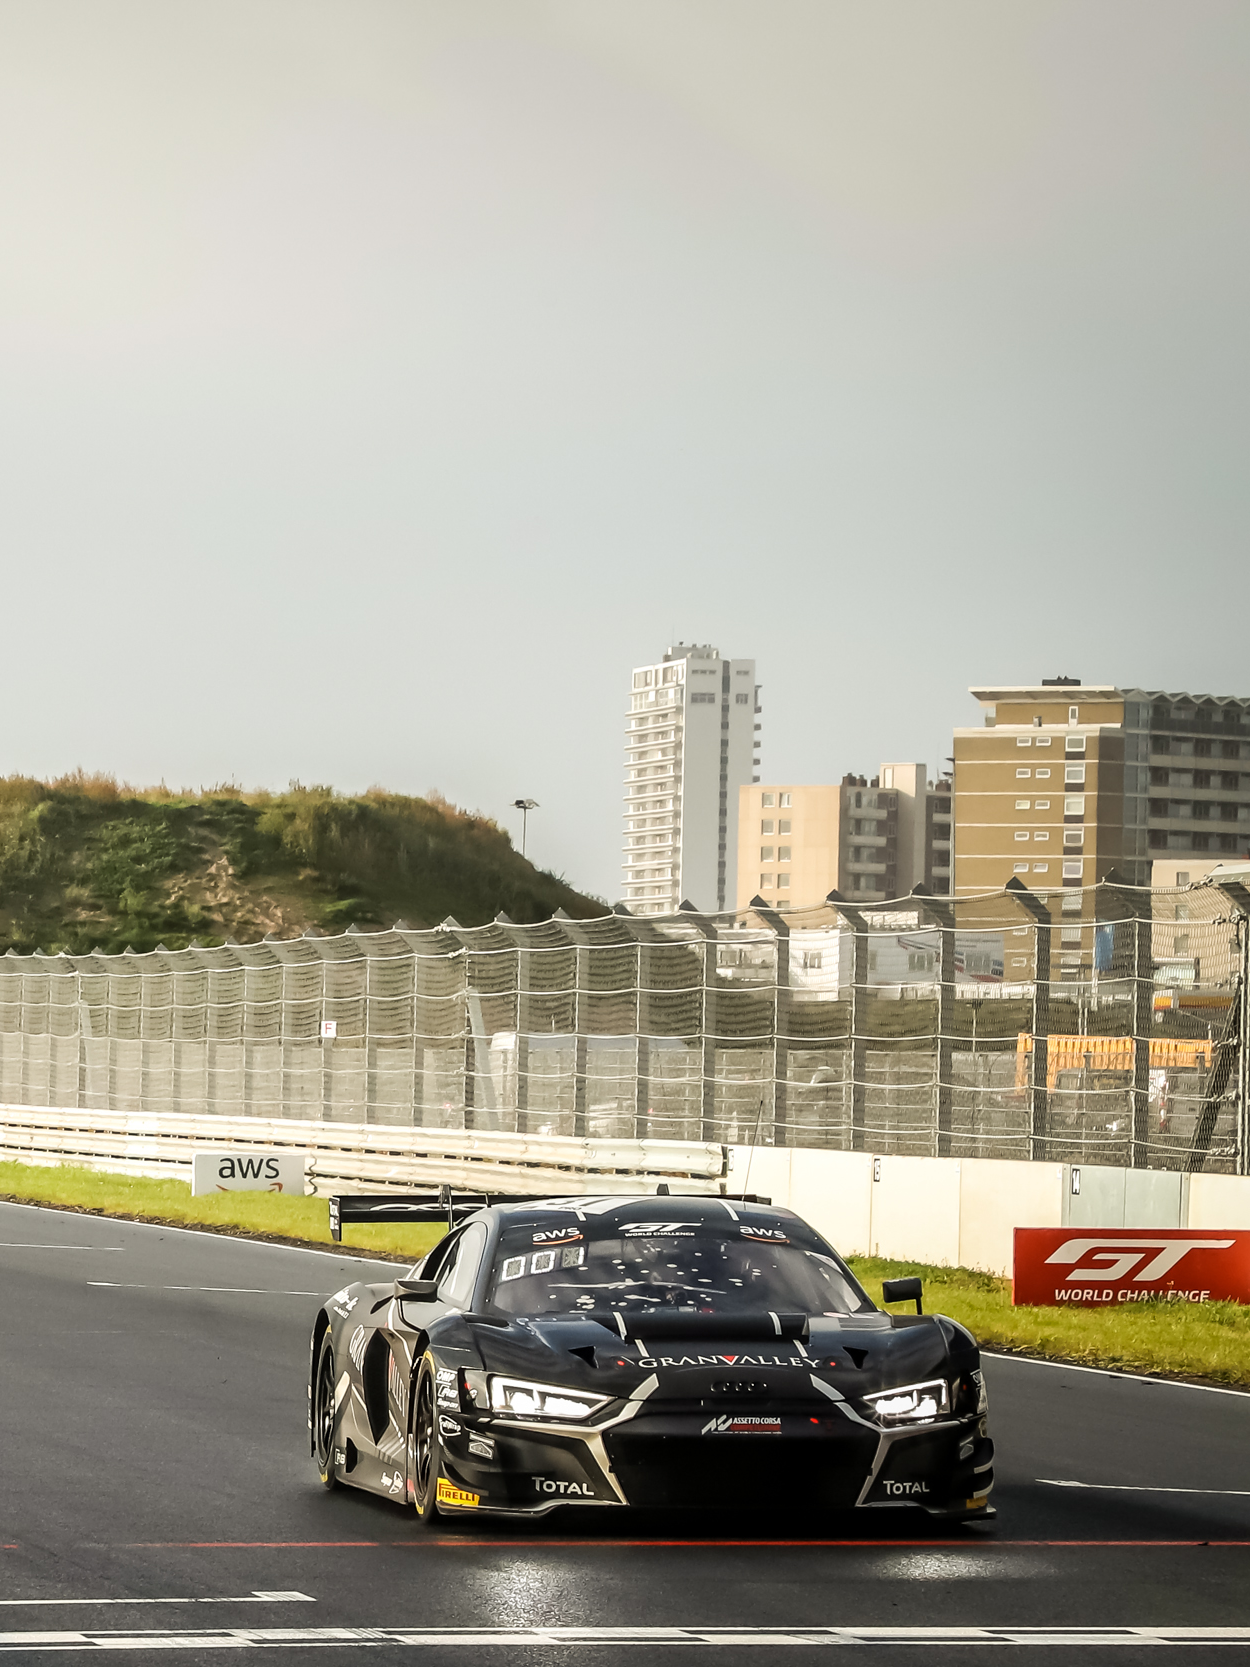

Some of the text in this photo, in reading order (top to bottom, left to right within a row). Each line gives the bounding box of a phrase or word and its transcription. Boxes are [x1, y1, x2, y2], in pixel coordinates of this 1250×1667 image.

[324, 1022, 333, 1035] F
[218, 1157, 280, 1179] aws
[532, 1226, 581, 1242] aws
[618, 1222, 702, 1233] GT
[739, 1225, 787, 1239] aws
[1043, 1238, 1237, 1282] GT
[1054, 1288, 1114, 1302] WORLD
[436, 1369, 457, 1383] OMP
[732, 1417, 782, 1425] ASSETTO CORSA
[438, 1482, 476, 1502] PIRELLI
[531, 1476, 595, 1496] TOTAL
[883, 1480, 930, 1495] TOTAL
